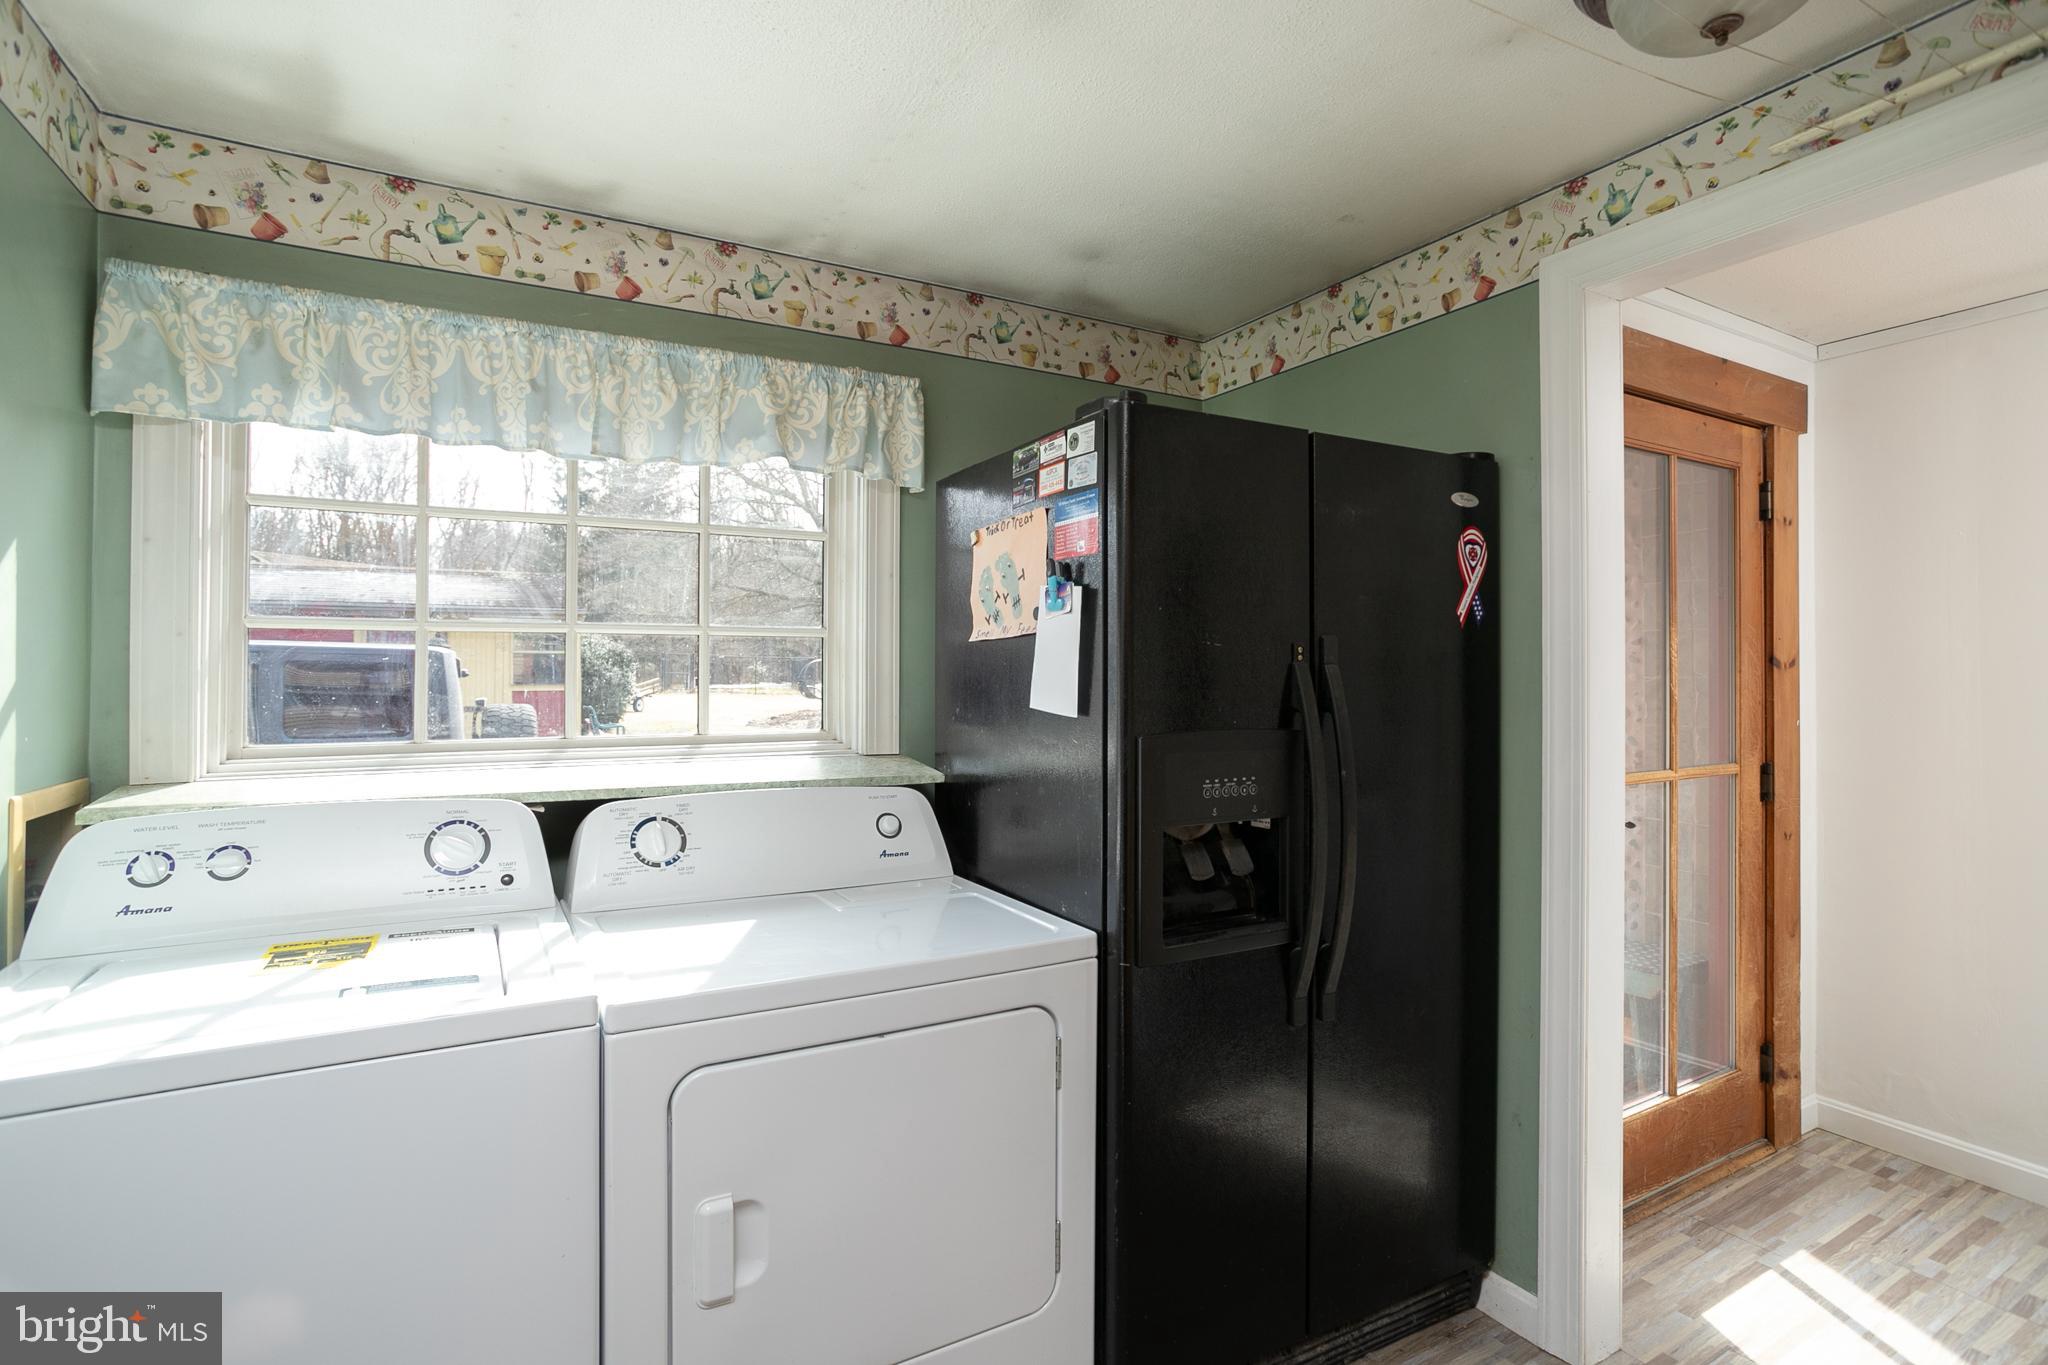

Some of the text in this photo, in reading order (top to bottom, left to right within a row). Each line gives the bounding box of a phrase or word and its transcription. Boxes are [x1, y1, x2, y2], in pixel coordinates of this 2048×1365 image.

[985, 513, 1034, 537] Trick Or Treat
[879, 849, 909, 859] Amana
[116, 905, 173, 917] Amana
